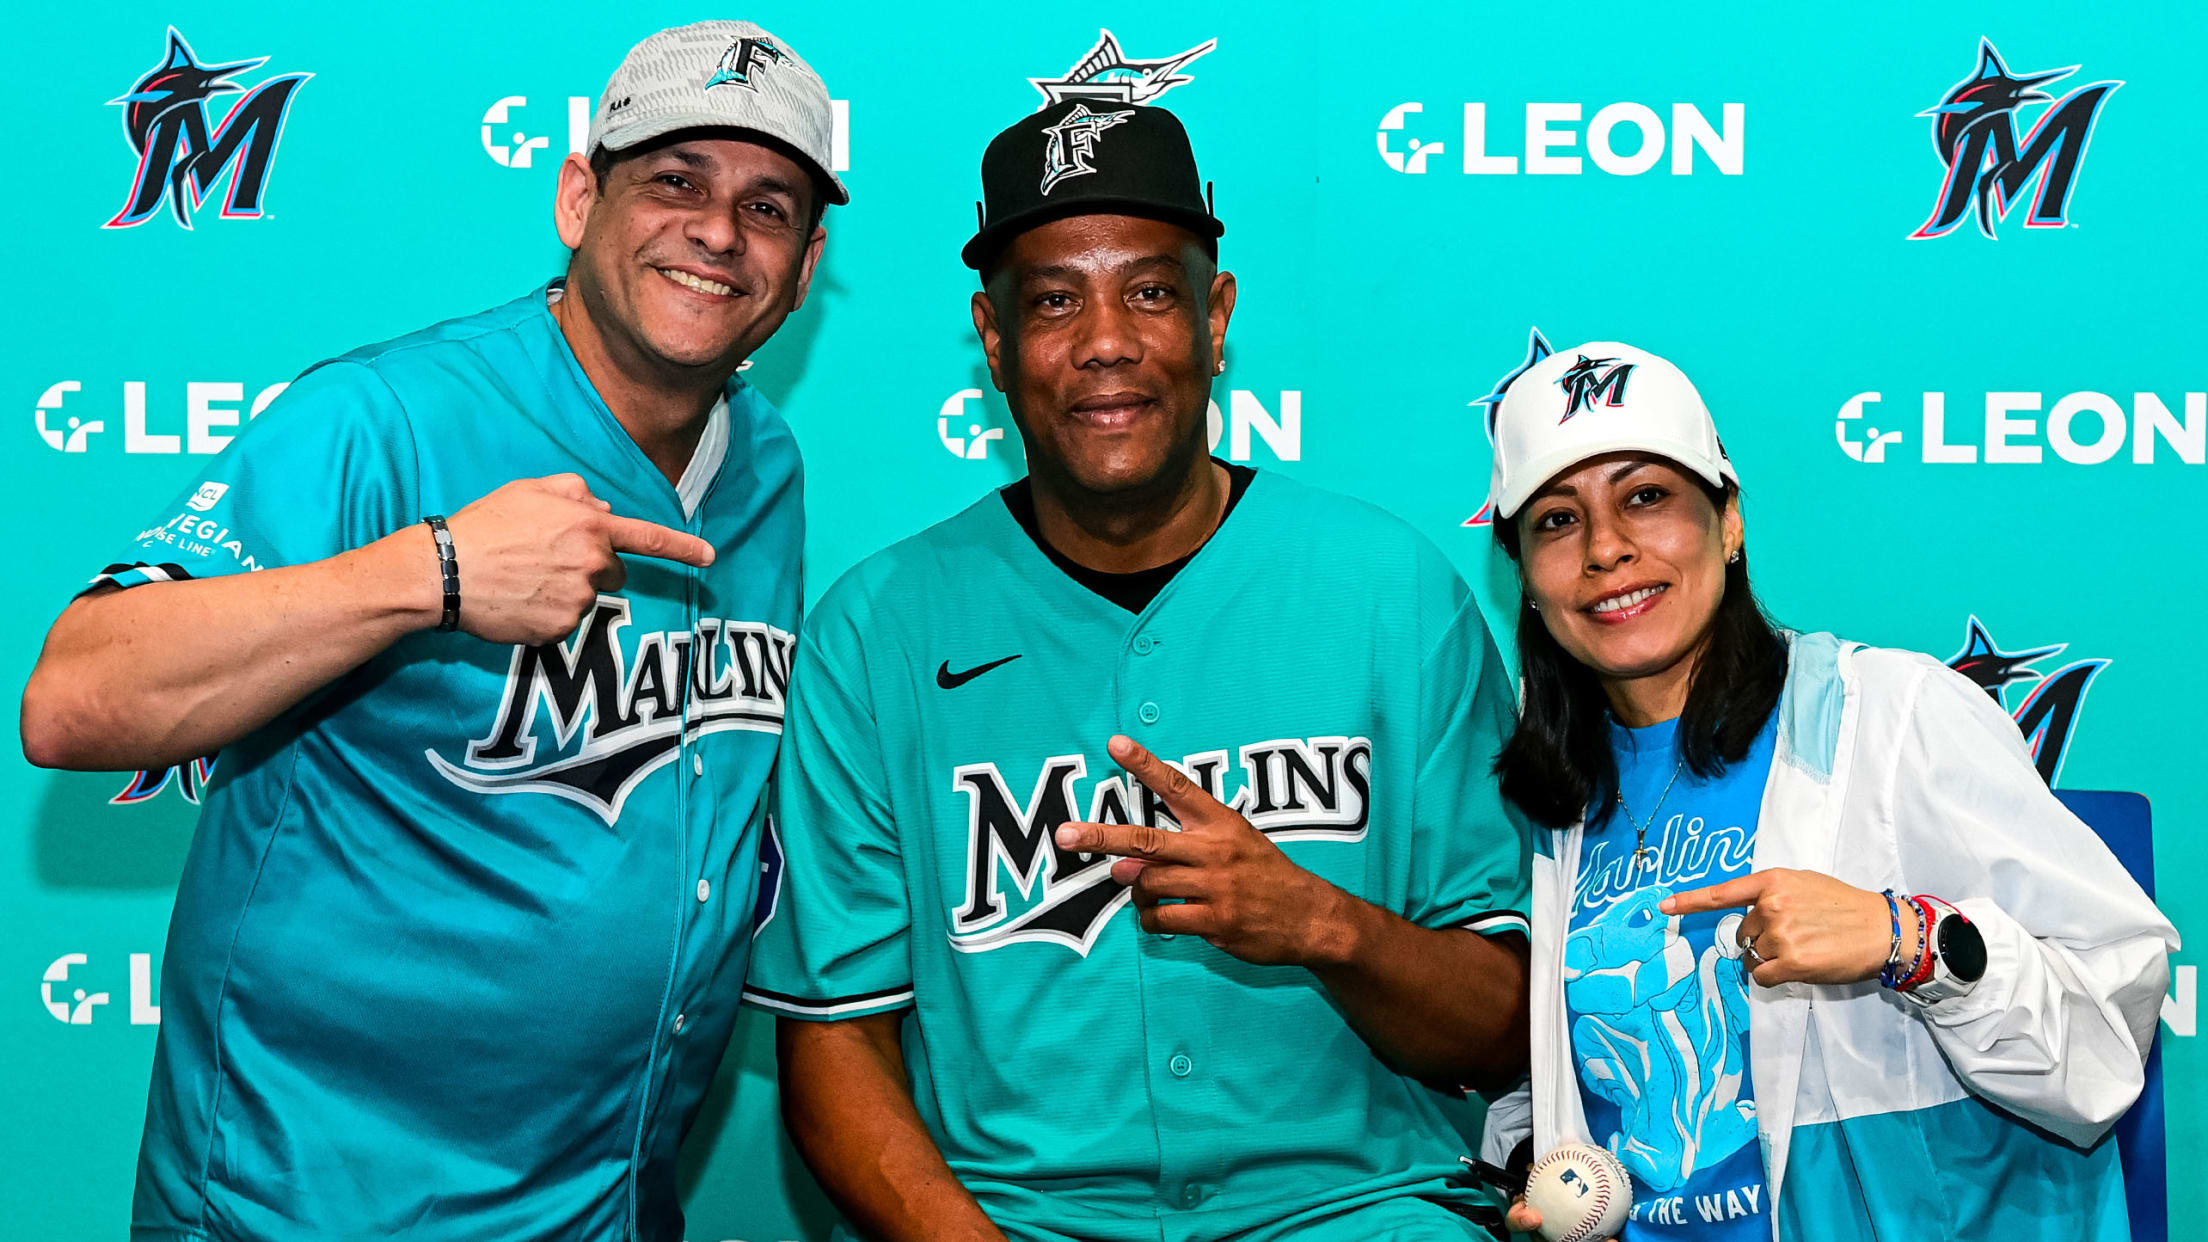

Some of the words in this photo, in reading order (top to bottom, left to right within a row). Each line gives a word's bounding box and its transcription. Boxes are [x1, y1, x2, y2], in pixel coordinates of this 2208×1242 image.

[1463, 101, 1745, 176] LEON
[124, 380, 290, 454] LE
[1922, 390, 2206, 465] LEON
[464, 594, 796, 769] MARLIN
[1695, 1184, 1761, 1224] WAY
